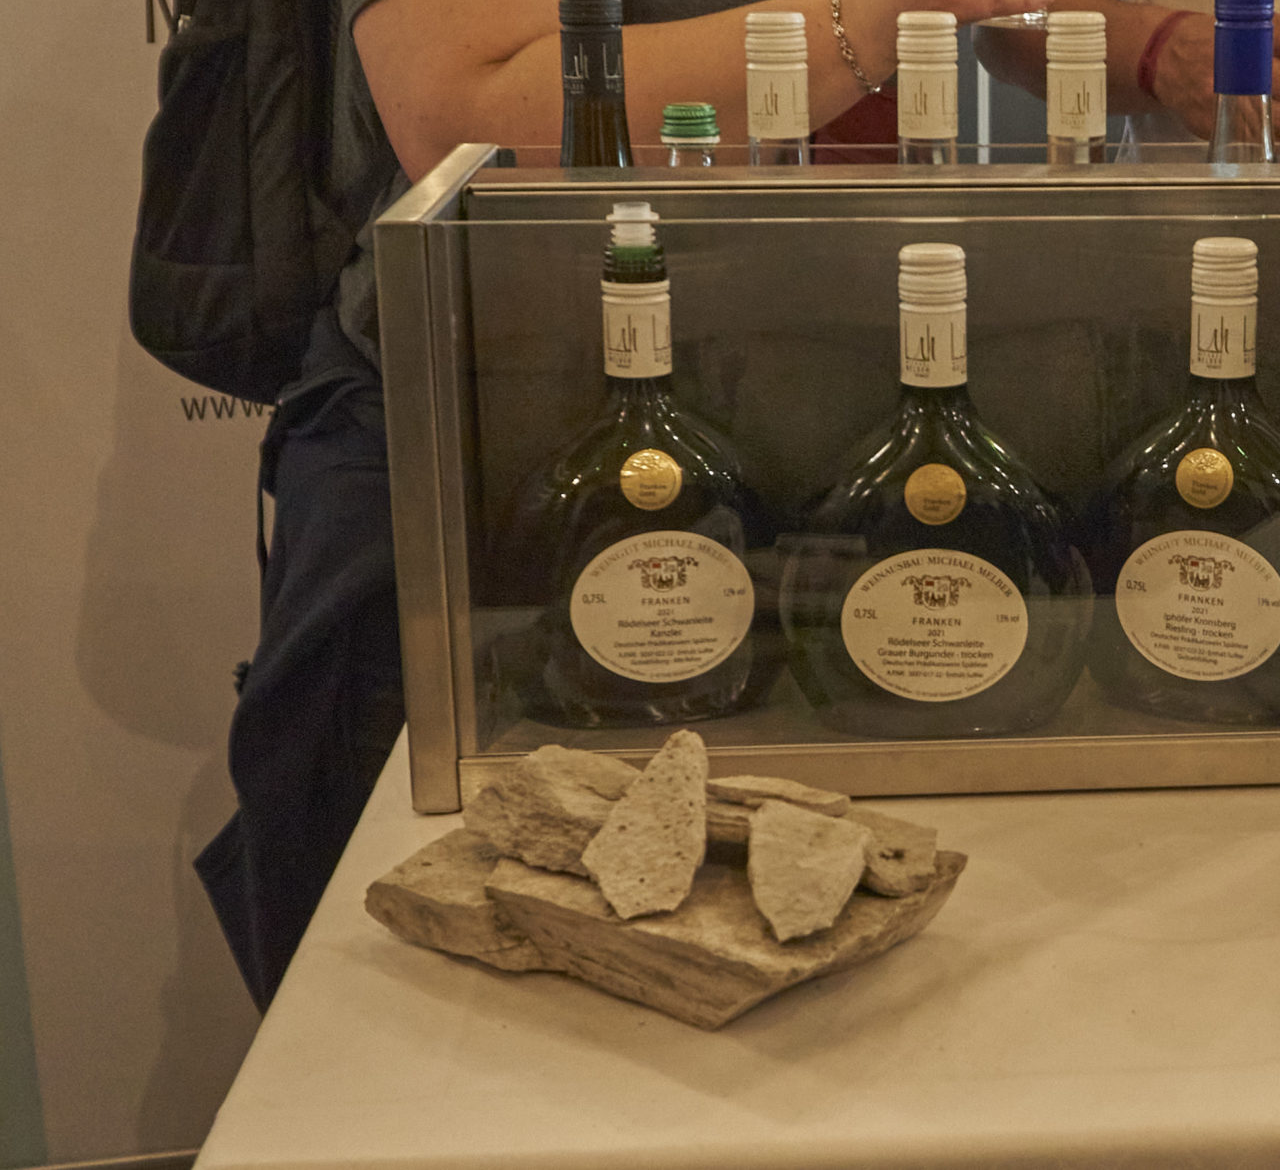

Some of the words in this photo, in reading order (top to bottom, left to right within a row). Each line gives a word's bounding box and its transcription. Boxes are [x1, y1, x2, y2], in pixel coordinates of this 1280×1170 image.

[1135, 538, 1180, 566] WEINGUT
[1183, 537, 1231, 552] MICHAEL
[860, 558, 923, 593] WEINAUSBAU
[927, 556, 975, 571] MICHAEL
[977, 566, 1013, 598] MELBER
[582, 593, 607, 604] 0,75L
[641, 596, 690, 606] FRANKEN
[1178, 593, 1224, 606] FRANKEN
[854, 609, 878, 620] 0,75L
[1192, 606, 1208, 615] 2021
[912, 617, 961, 626] FRANKEN
[927, 629, 945, 638] 2021
[877, 648, 907, 658] Grauer
[909, 649, 955, 660] Burgunder
[960, 650, 994, 660] trocken
